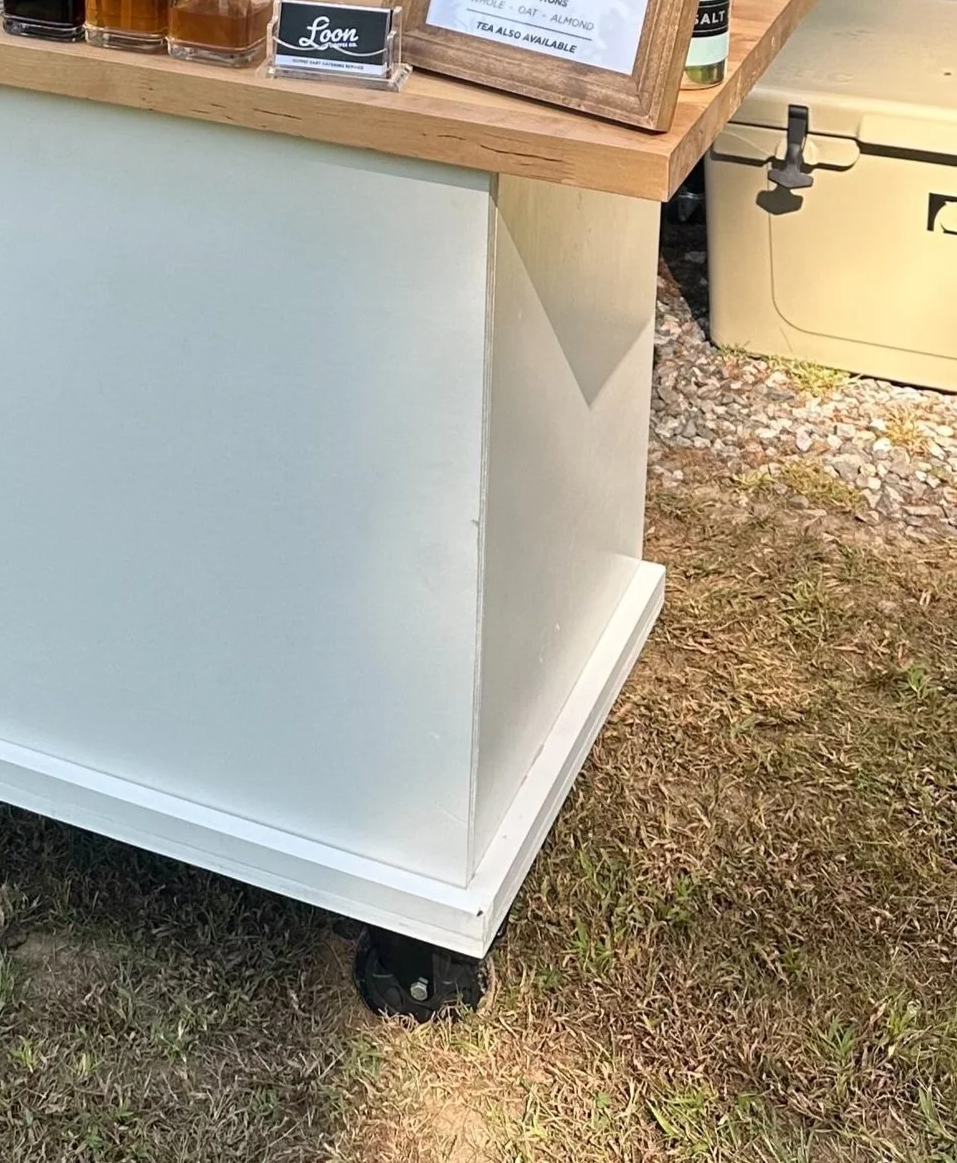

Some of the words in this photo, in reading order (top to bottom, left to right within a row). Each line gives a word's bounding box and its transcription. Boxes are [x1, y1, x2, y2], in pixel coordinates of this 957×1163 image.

[299, 16, 359, 50] Loon
[518, 5, 538, 17] OAT
[550, 14, 594, 31] ALMOND
[476, 21, 494, 33] TEA
[495, 26, 521, 39] ALSO
[522, 33, 577, 54] AVAILABLE
